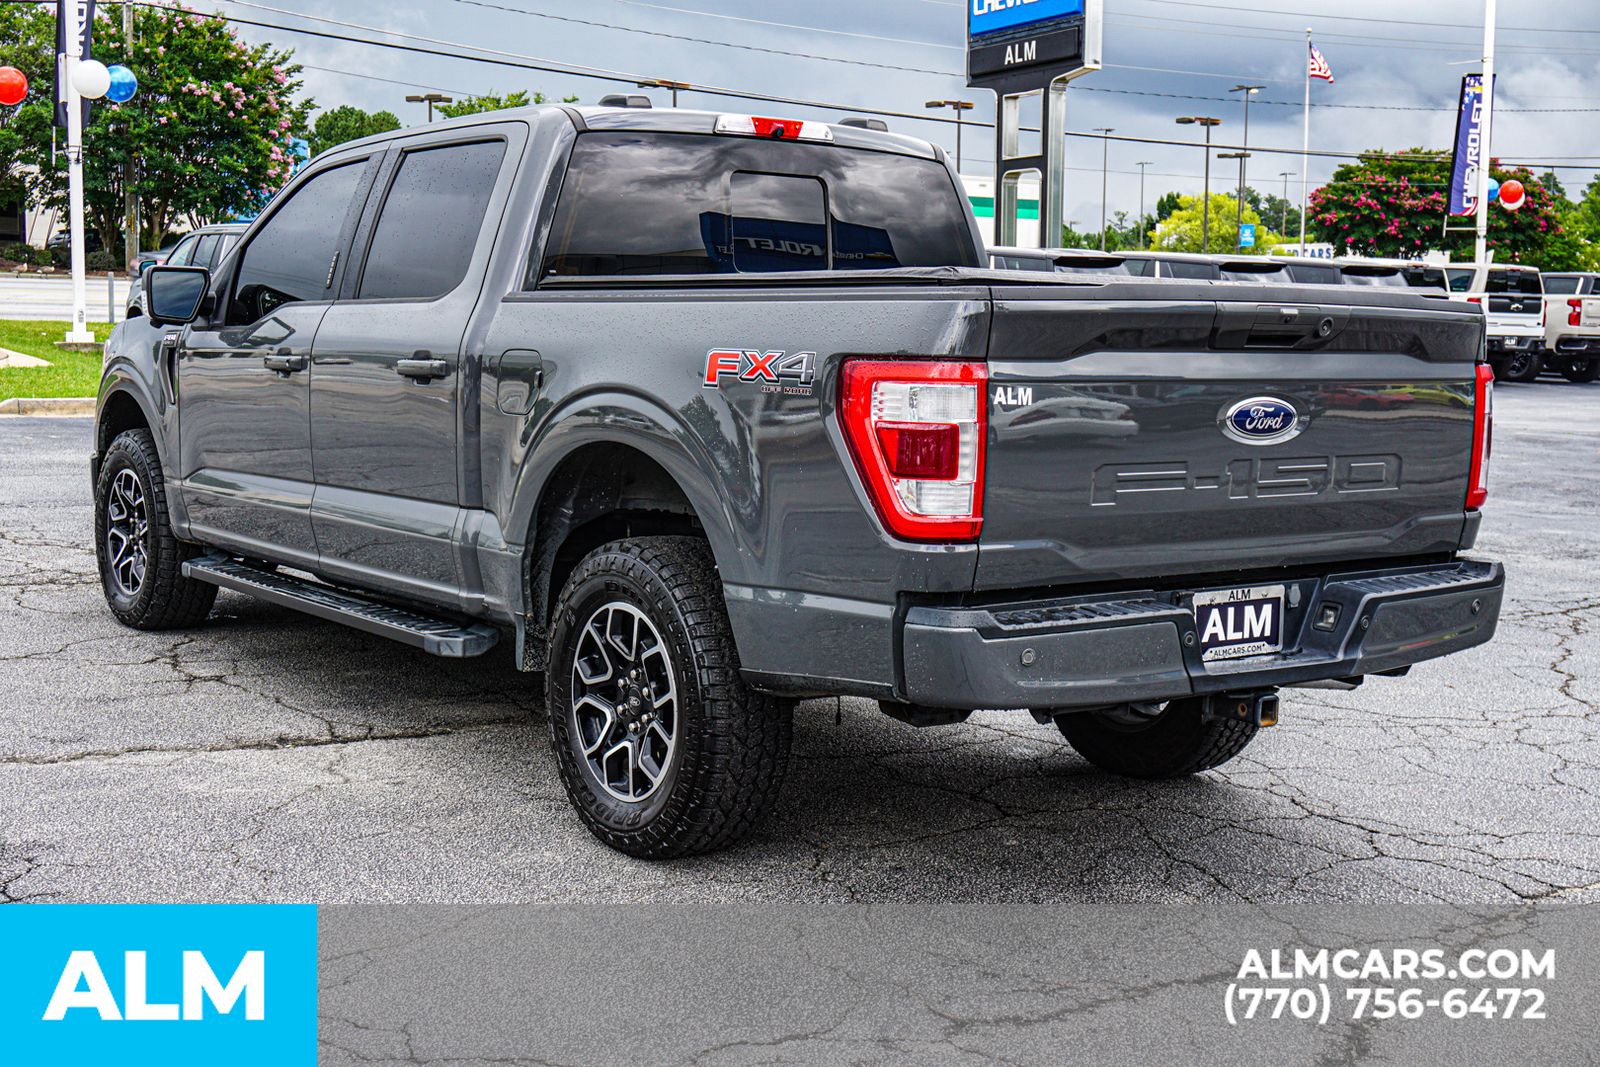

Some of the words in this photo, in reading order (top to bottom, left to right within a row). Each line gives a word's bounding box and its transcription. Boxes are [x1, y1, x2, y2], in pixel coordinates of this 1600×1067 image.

[1004, 40, 1037, 65] ALM
[702, 348, 816, 388] FX4
[993, 386, 1032, 405] ALM
[1245, 406, 1284, 430] Ford
[1090, 452, 1402, 506] F-150
[1228, 589, 1251, 602] ALM
[1201, 603, 1272, 643] ALM
[1213, 645, 1262, 657] ALMCARS.COM
